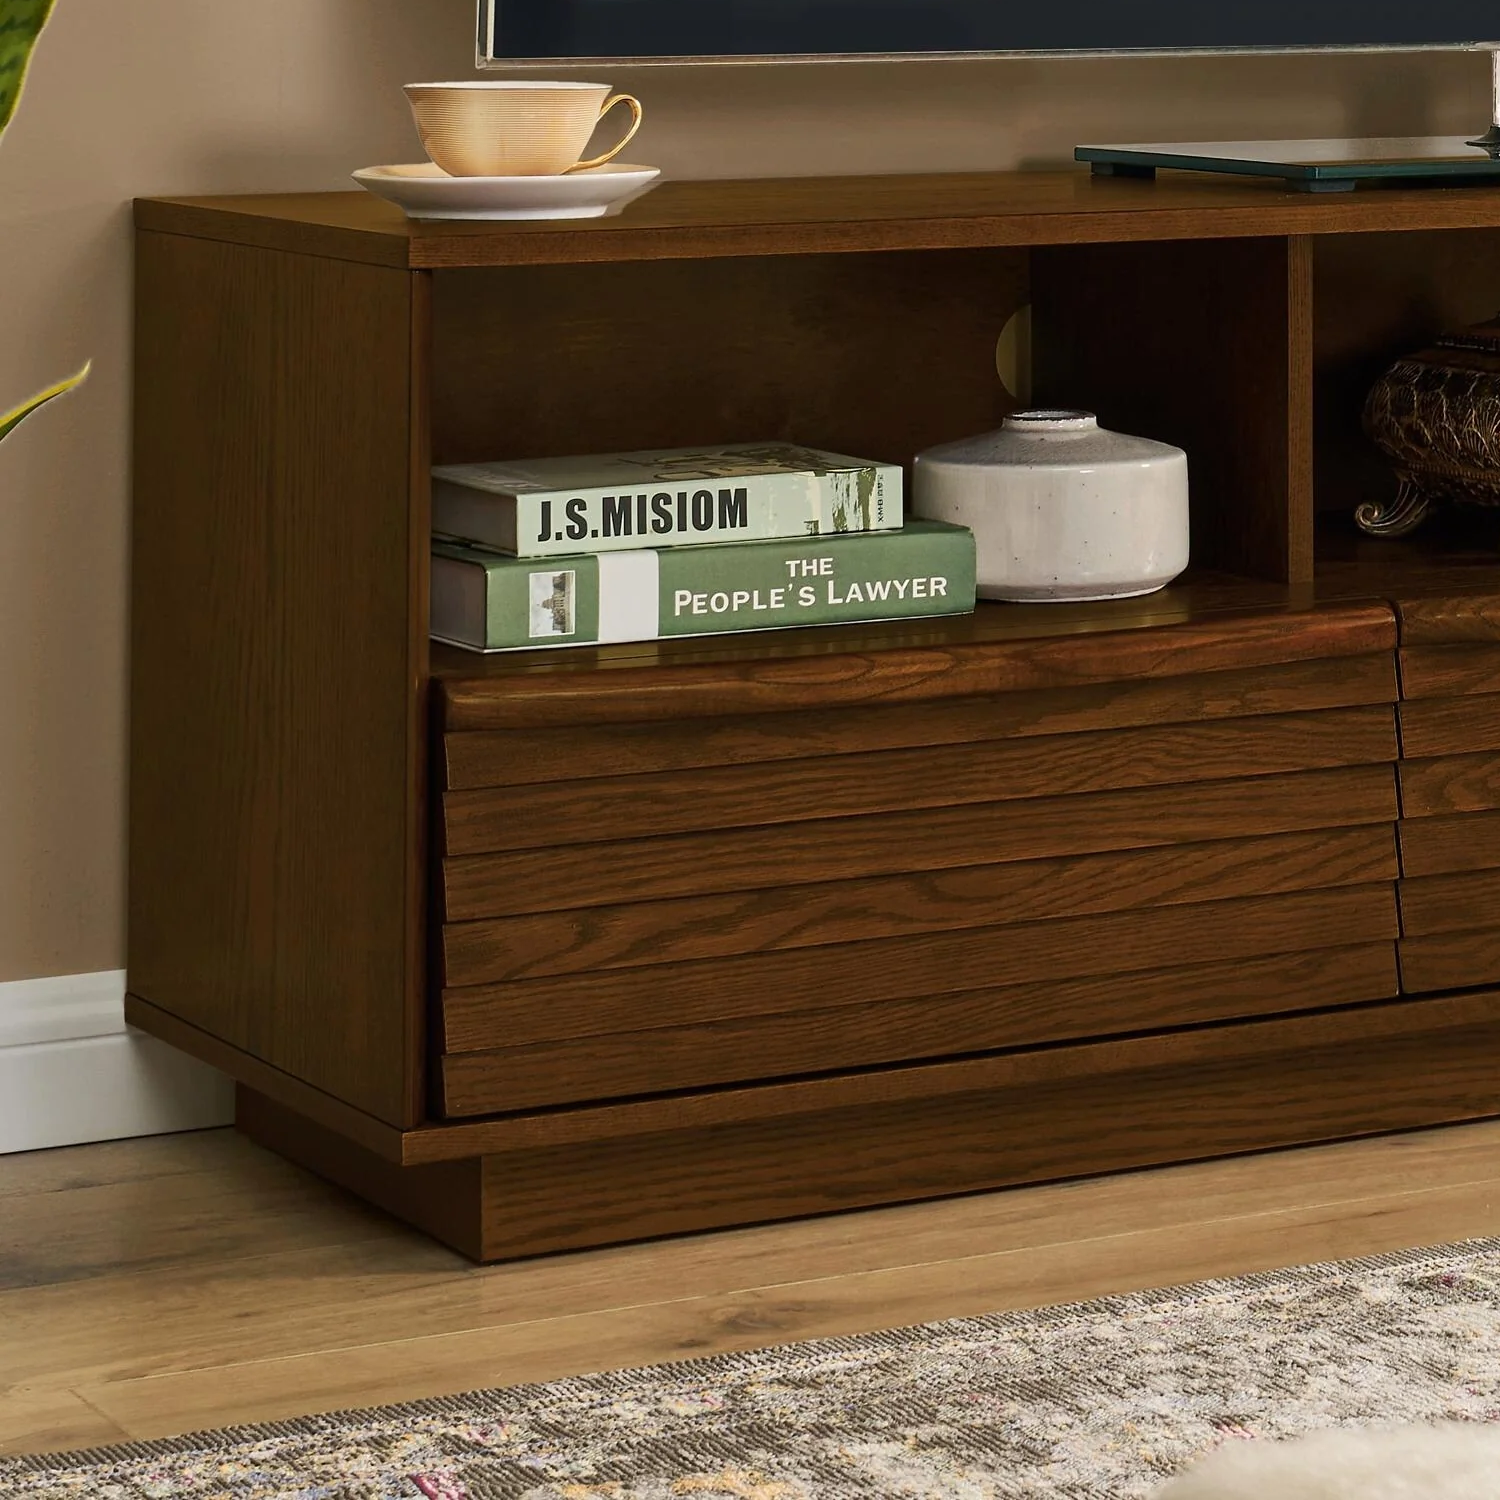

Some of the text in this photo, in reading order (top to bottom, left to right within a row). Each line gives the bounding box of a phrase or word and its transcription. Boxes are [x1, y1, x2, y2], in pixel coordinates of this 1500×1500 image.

[537, 488, 748, 542] J.S.MISIOM
[785, 557, 834, 578] THE
[827, 576, 948, 604] LAWYER
